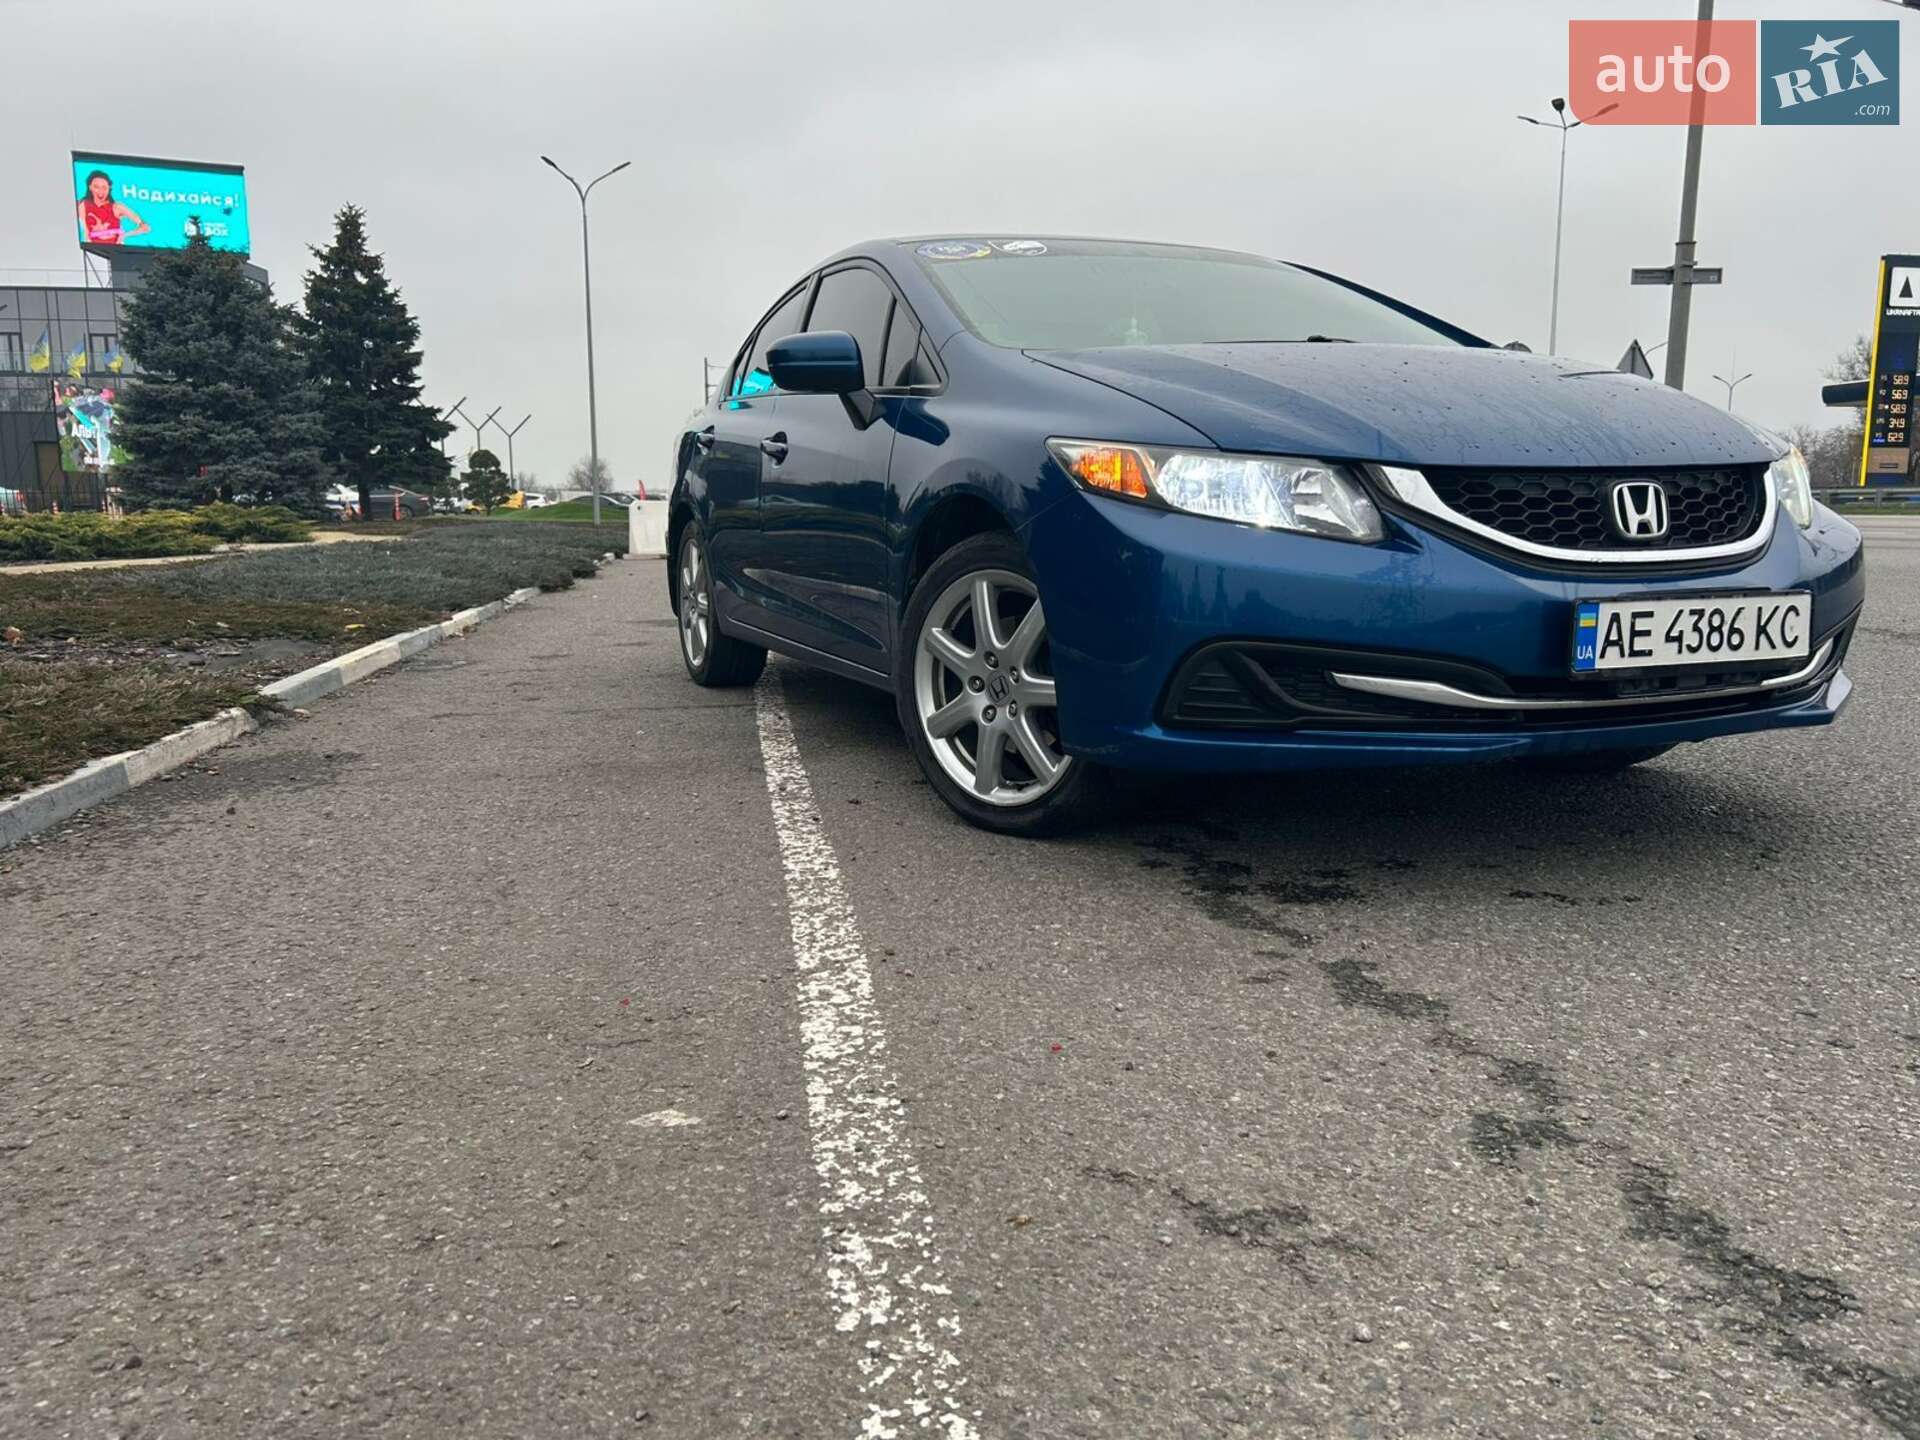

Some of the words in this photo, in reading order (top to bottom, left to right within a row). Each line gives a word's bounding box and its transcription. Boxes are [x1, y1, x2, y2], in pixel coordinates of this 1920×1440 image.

[122, 184, 240, 208] Надихайся!
[1599, 611, 1655, 658] AE
[1664, 606, 1746, 654] 4386
[1754, 604, 1801, 650] KC
[1577, 645, 1593, 659] UA
